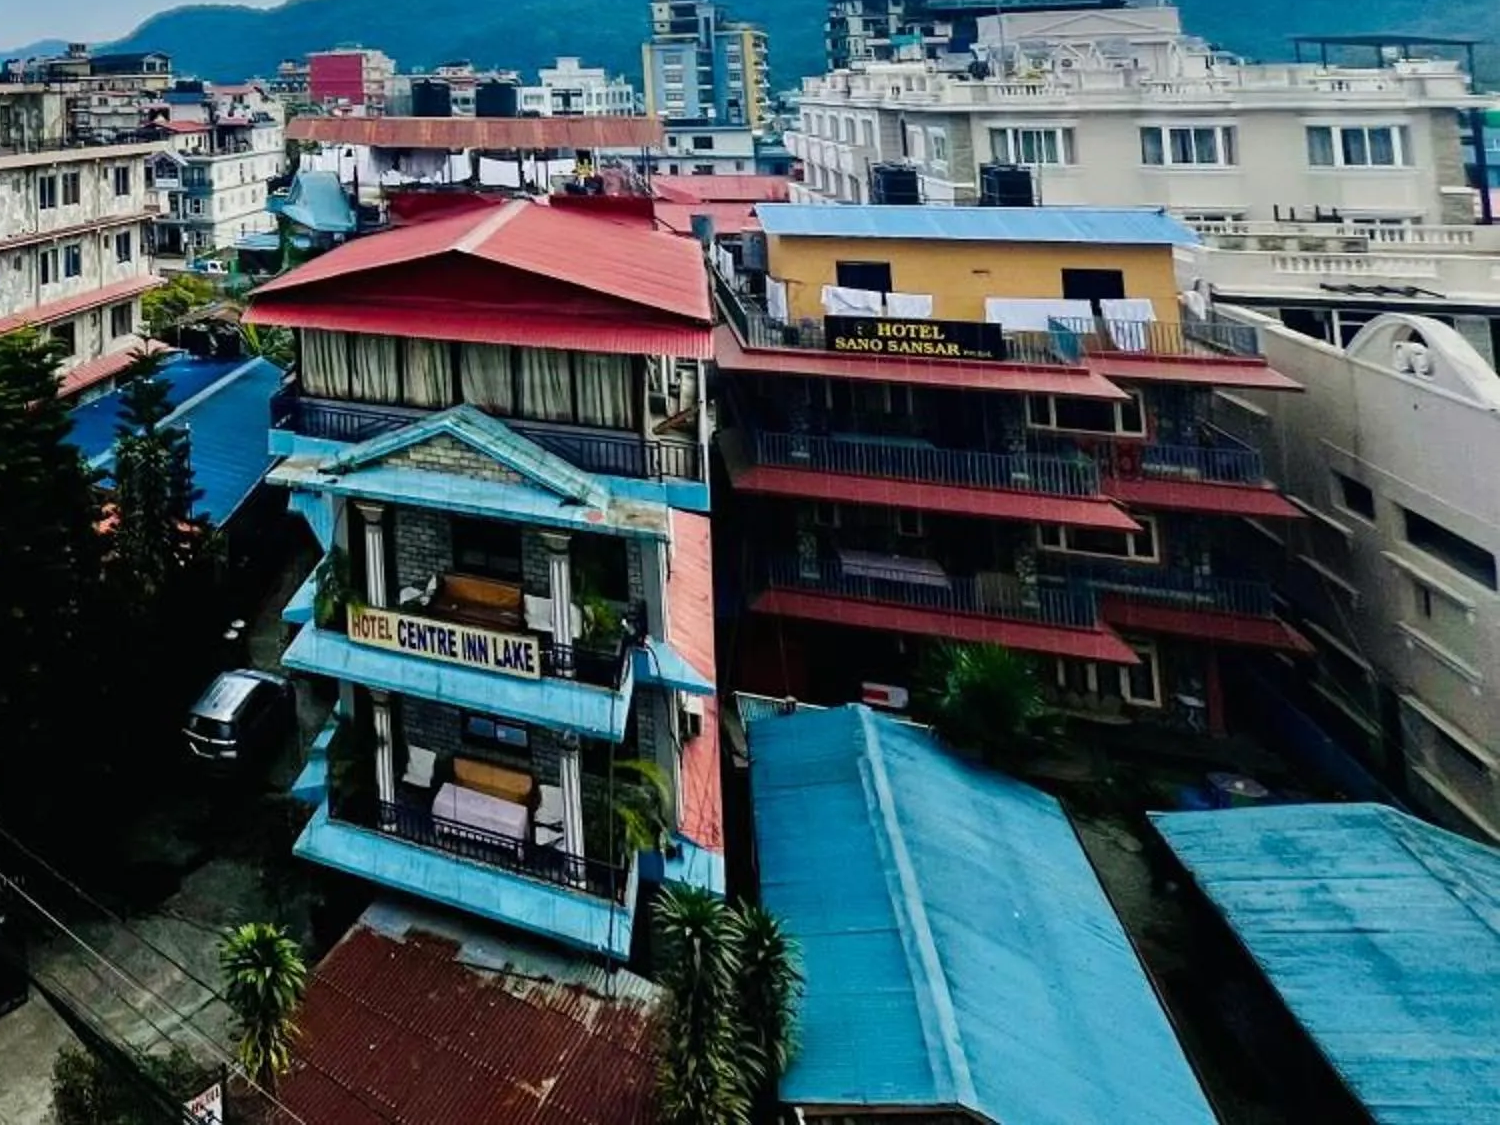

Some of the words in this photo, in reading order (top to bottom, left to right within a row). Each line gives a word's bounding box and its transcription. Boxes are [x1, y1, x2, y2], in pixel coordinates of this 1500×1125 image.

[877, 322, 945, 340] HOTEL
[835, 336, 883, 351] SANO
[888, 340, 961, 356] SANSAR
[352, 614, 393, 641] HOTEL
[397, 618, 459, 658] CENTRE
[461, 632, 489, 664] INN
[493, 637, 536, 673] LAKE
